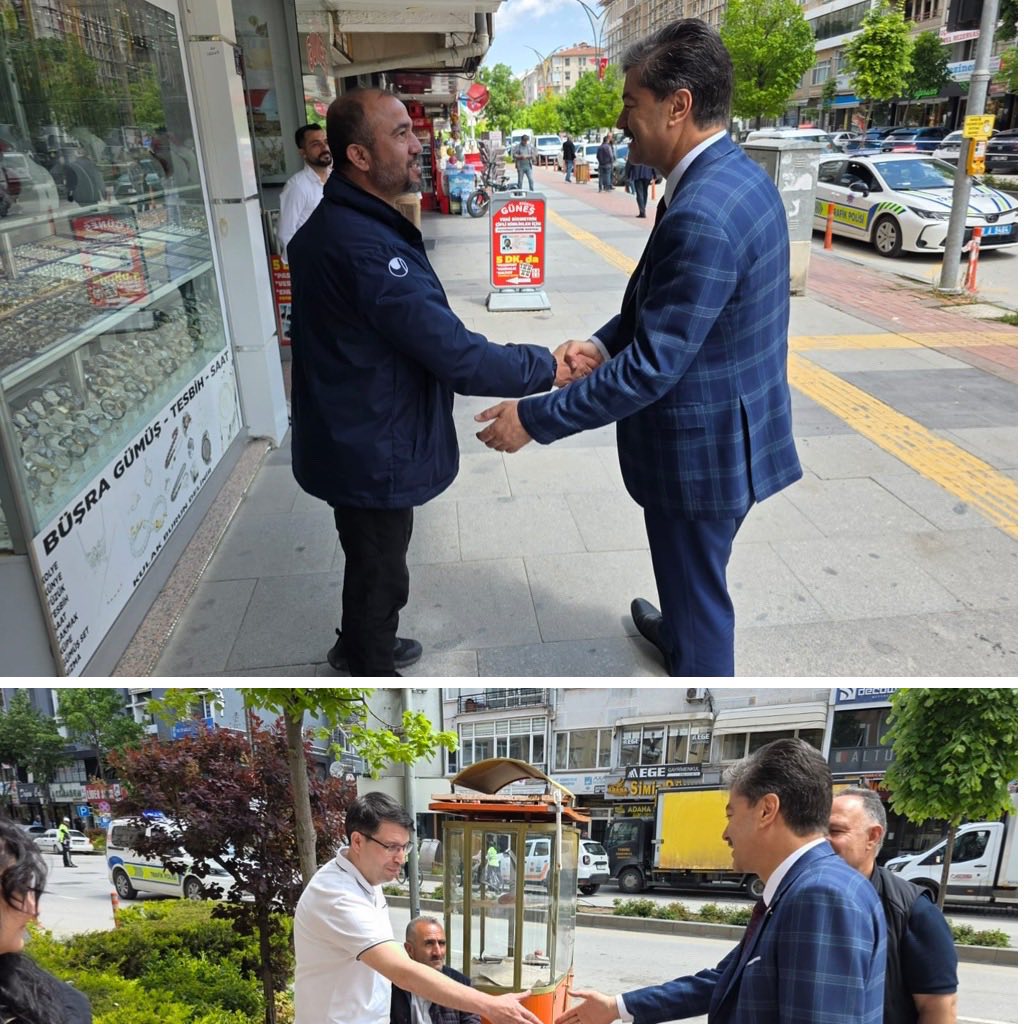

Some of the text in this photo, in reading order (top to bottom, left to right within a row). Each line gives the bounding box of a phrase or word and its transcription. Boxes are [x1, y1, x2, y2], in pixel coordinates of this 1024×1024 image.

[501, 204, 536, 216] GÜNEŞ
[43, 477, 111, 556] BÜŞRA
[113, 421, 162, 480] GÜMÜŞ
[170, 379, 205, 418] TESBİH
[211, 351, 230, 378] SAAT
[851, 749, 894, 762] ALTU
[640, 767, 666, 778] EGE
